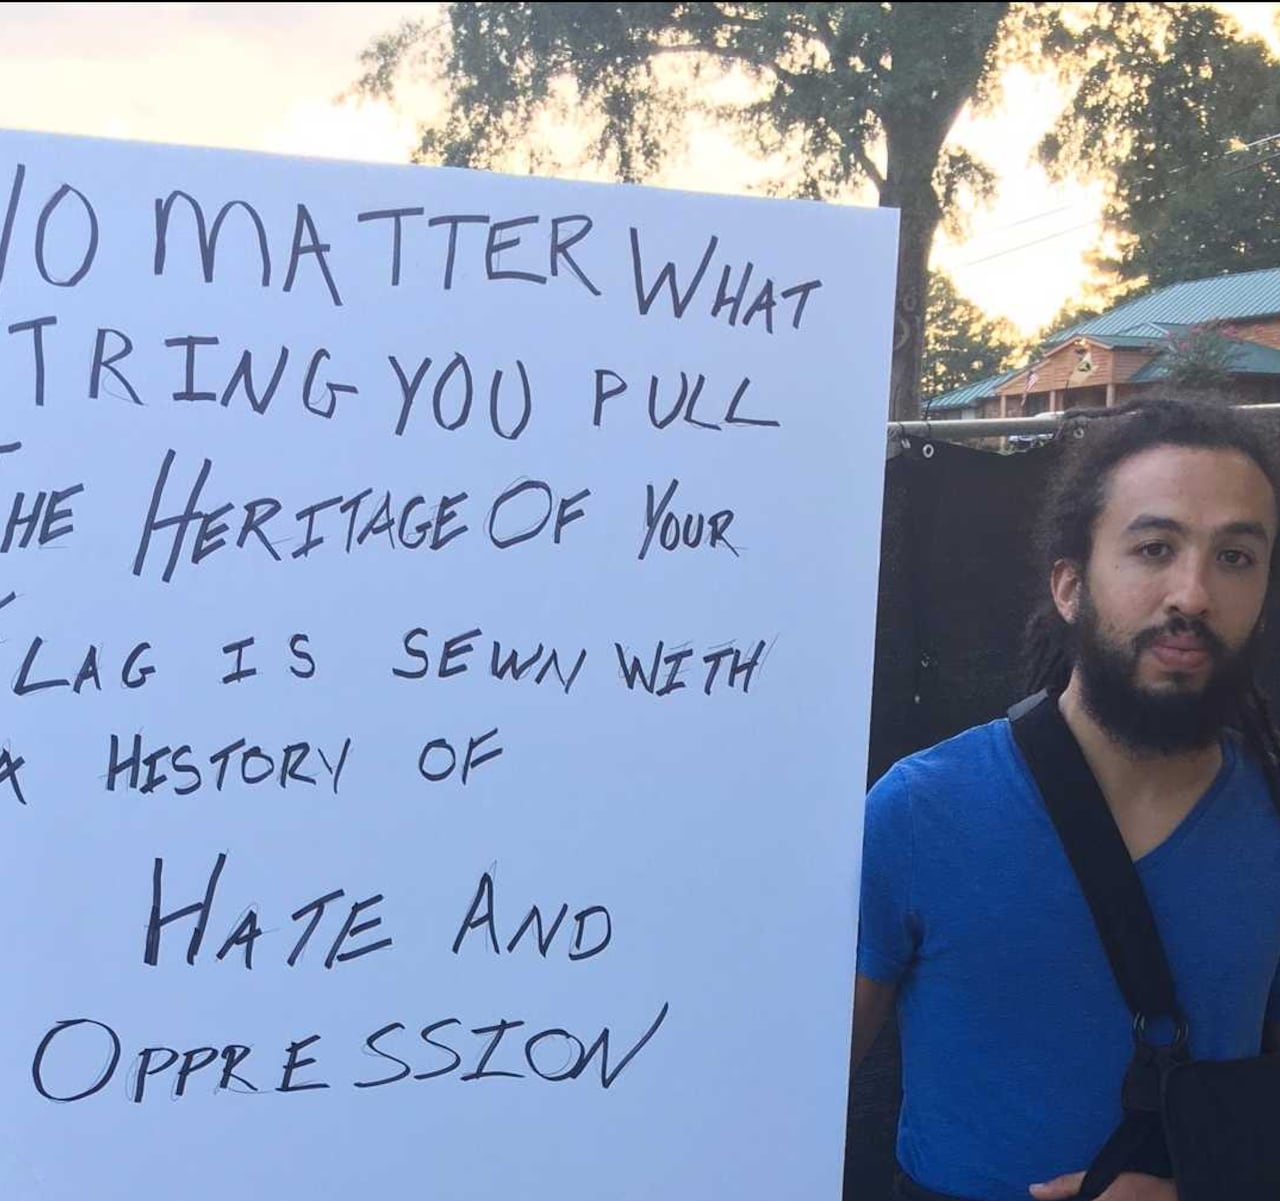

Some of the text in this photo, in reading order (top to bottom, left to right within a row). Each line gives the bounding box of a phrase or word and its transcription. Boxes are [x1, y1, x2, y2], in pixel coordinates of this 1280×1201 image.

[154, 190, 601, 305] MATTER
[630, 227, 822, 333] WHAT
[389, 353, 531, 440] YOU
[594, 369, 780, 430] PULL
[132, 449, 468, 582] HERITAGE
[486, 480, 591, 550] OF
[638, 478, 740, 560] YOUR
[221, 633, 316, 684] IS
[392, 627, 586, 694] SEWN
[615, 640, 766, 697] WITH
[106, 734, 351, 795] HISTORY
[419, 728, 503, 785] OF
[144, 853, 611, 969] HATE AND
[32, 1001, 669, 1103] OPPRESSION
